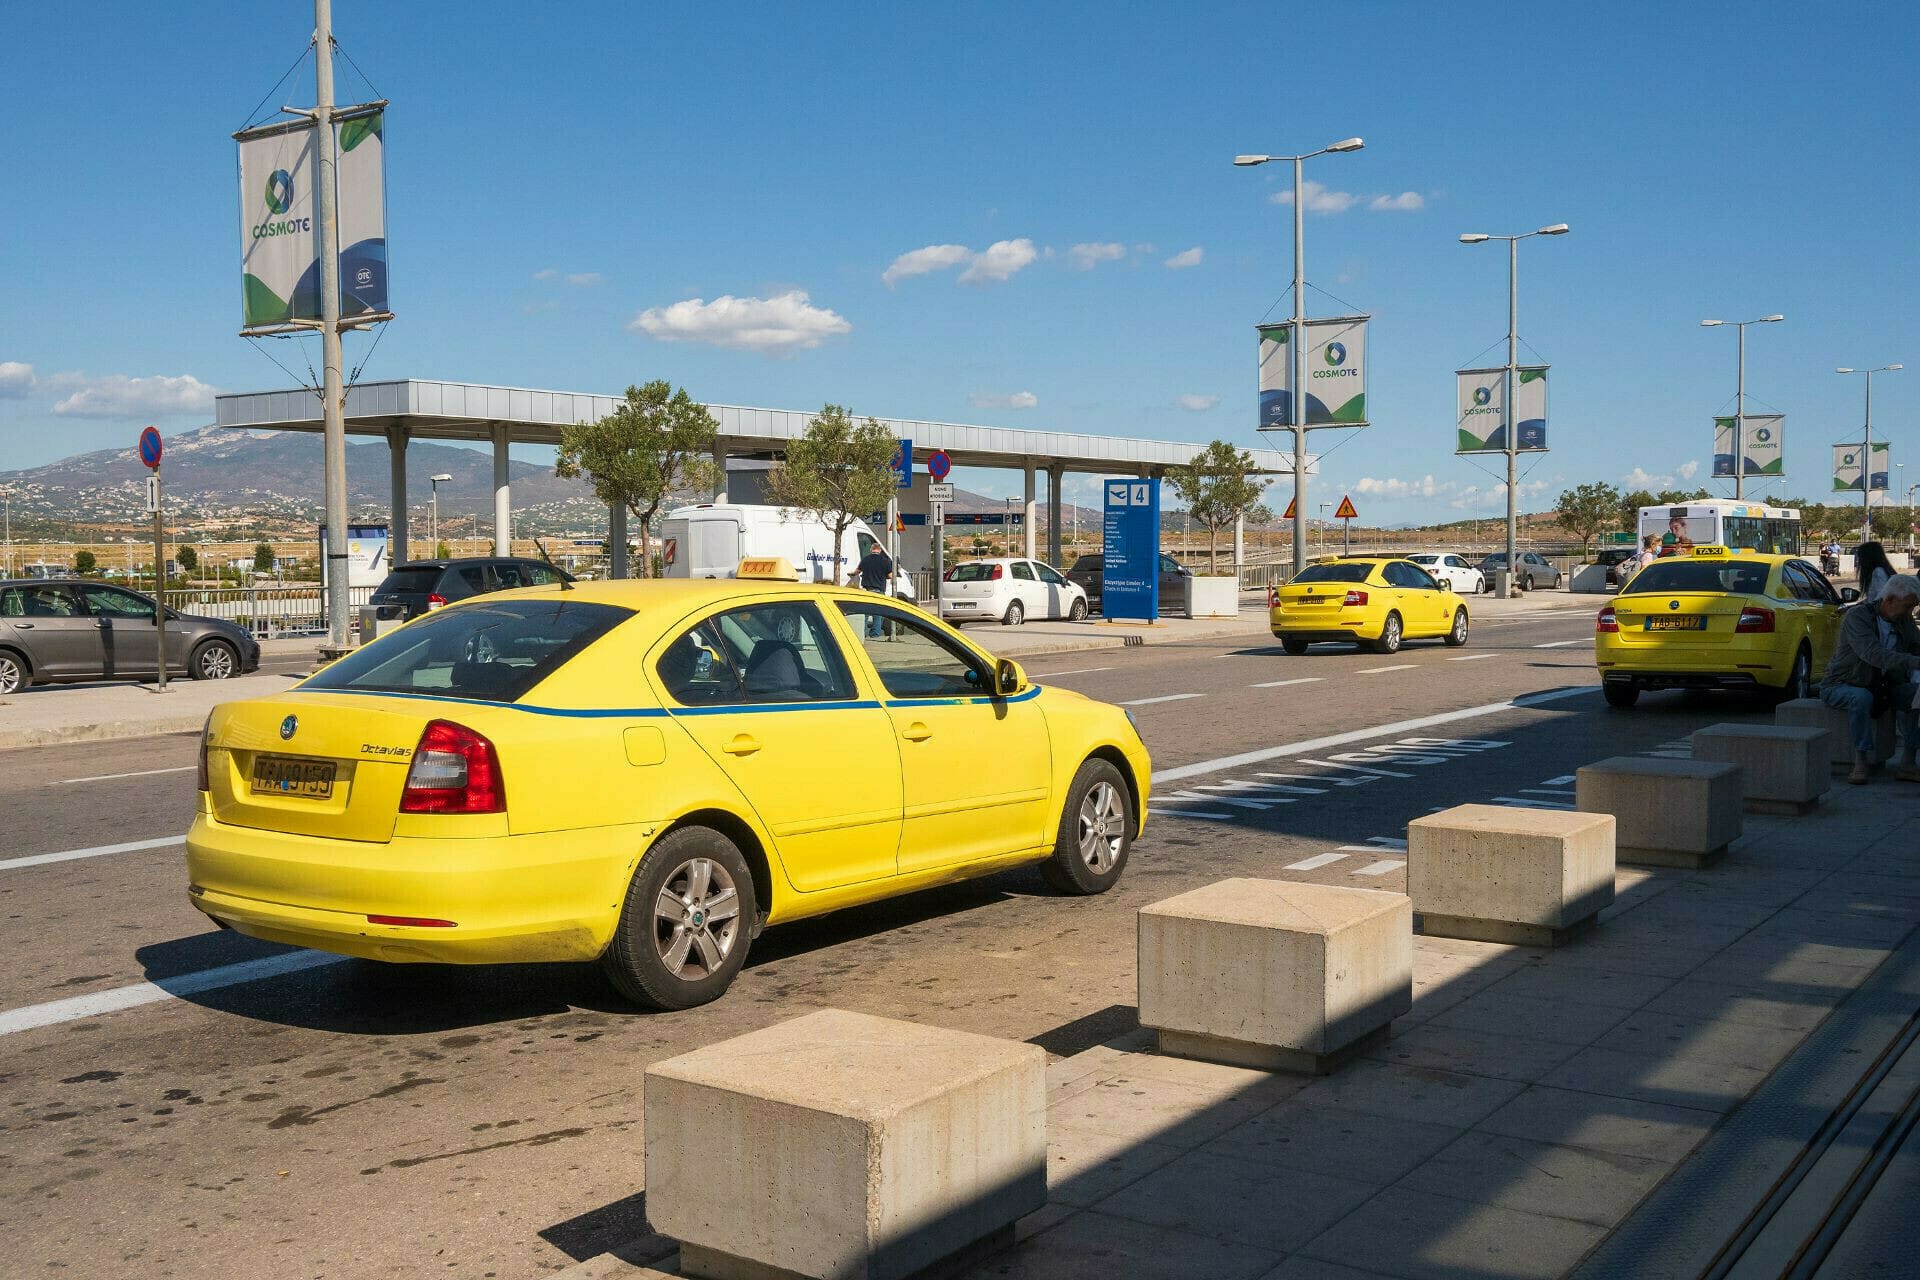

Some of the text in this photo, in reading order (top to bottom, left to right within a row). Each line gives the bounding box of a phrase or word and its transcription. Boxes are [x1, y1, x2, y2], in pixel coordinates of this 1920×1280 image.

[252, 217, 310, 240] COSMOTE
[1312, 367, 1358, 379] COSMOTE
[1464, 406, 1501, 416] COSMOTE
[1136, 486, 1144, 503] 4
[743, 563, 776, 573] TAXI
